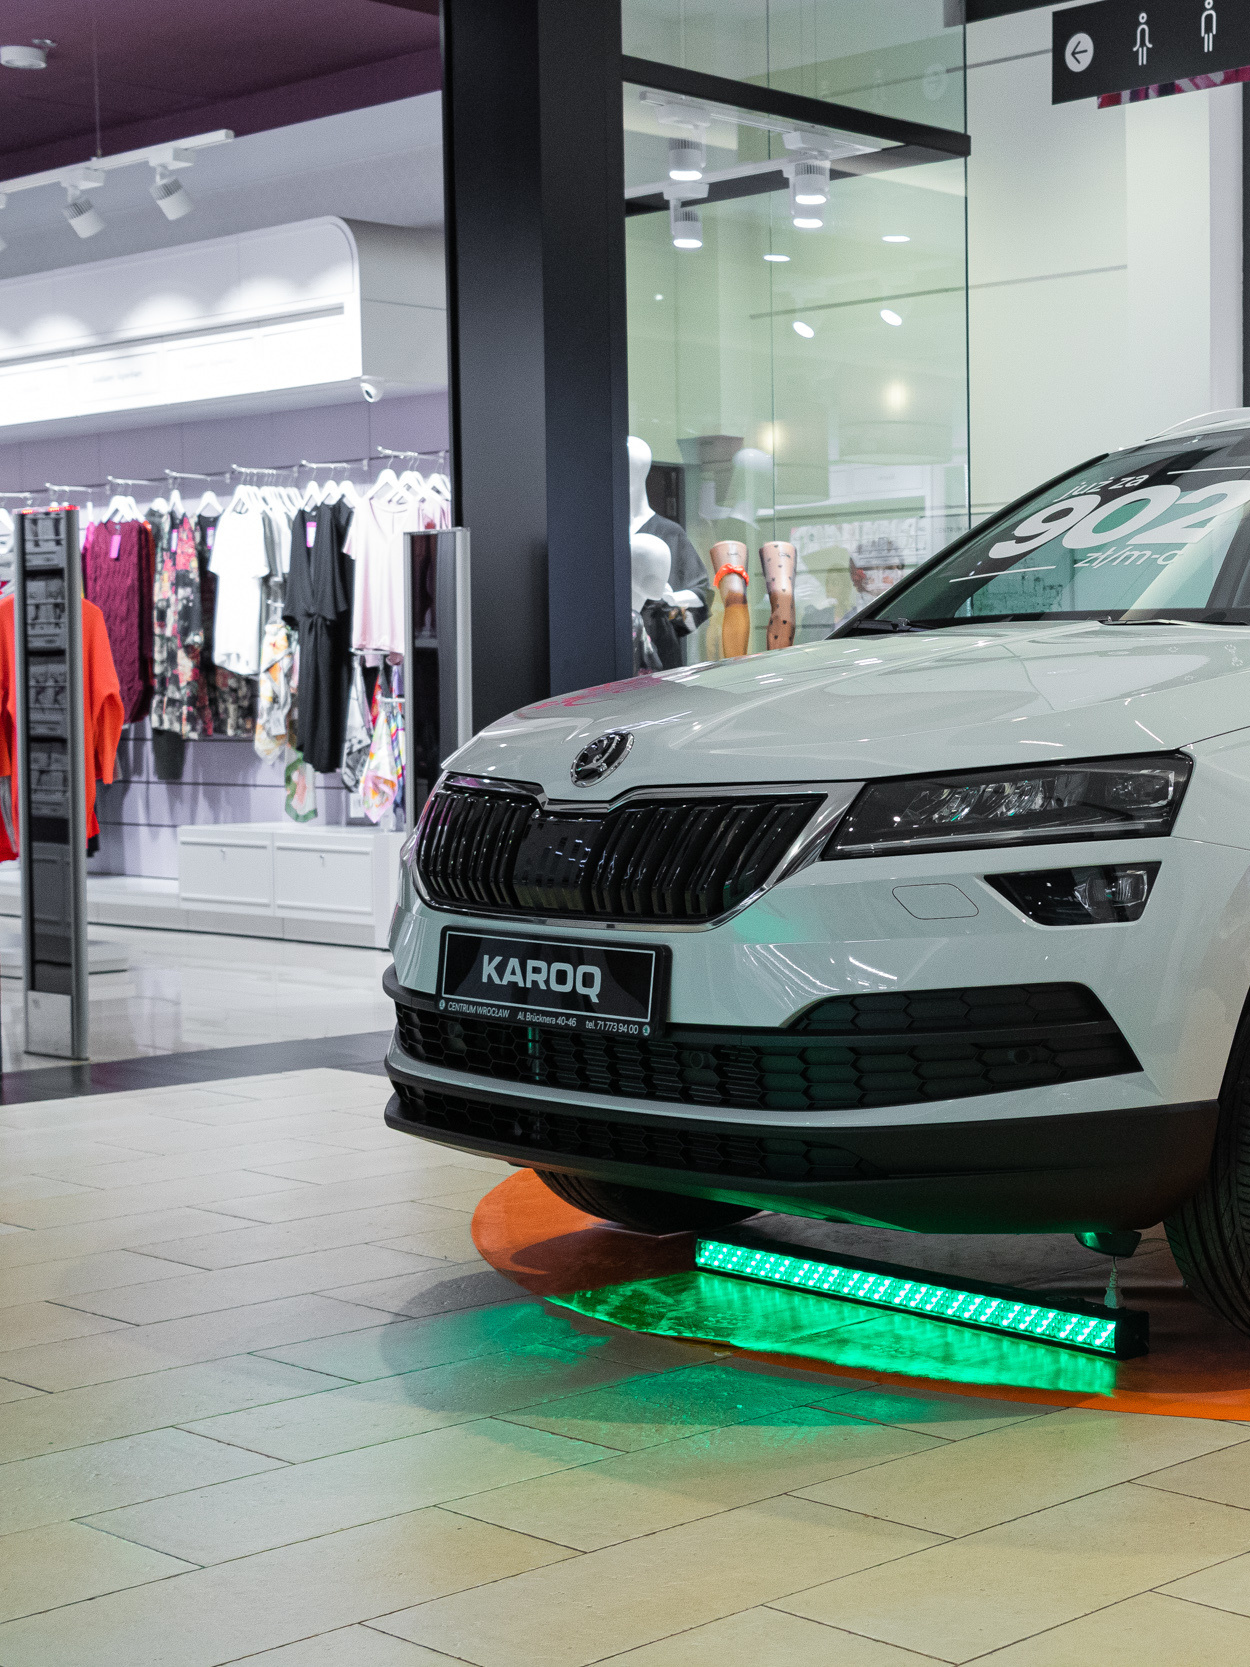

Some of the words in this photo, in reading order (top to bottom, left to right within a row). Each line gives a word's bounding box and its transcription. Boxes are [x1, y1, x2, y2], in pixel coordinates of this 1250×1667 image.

[1108, 474, 1150, 490] za
[482, 954, 602, 1003] KAROQ
[448, 1002, 476, 1014] CENTRUM
[476, 1005, 510, 1018] WROCŁAW
[526, 1012, 556, 1025] Brücknera
[557, 1016, 577, 1027] 40-46
[597, 1021, 604, 1031] 71
[605, 1021, 618, 1032] 773
[618, 1023, 628, 1034] 94
[628, 1024, 639, 1035] 00
